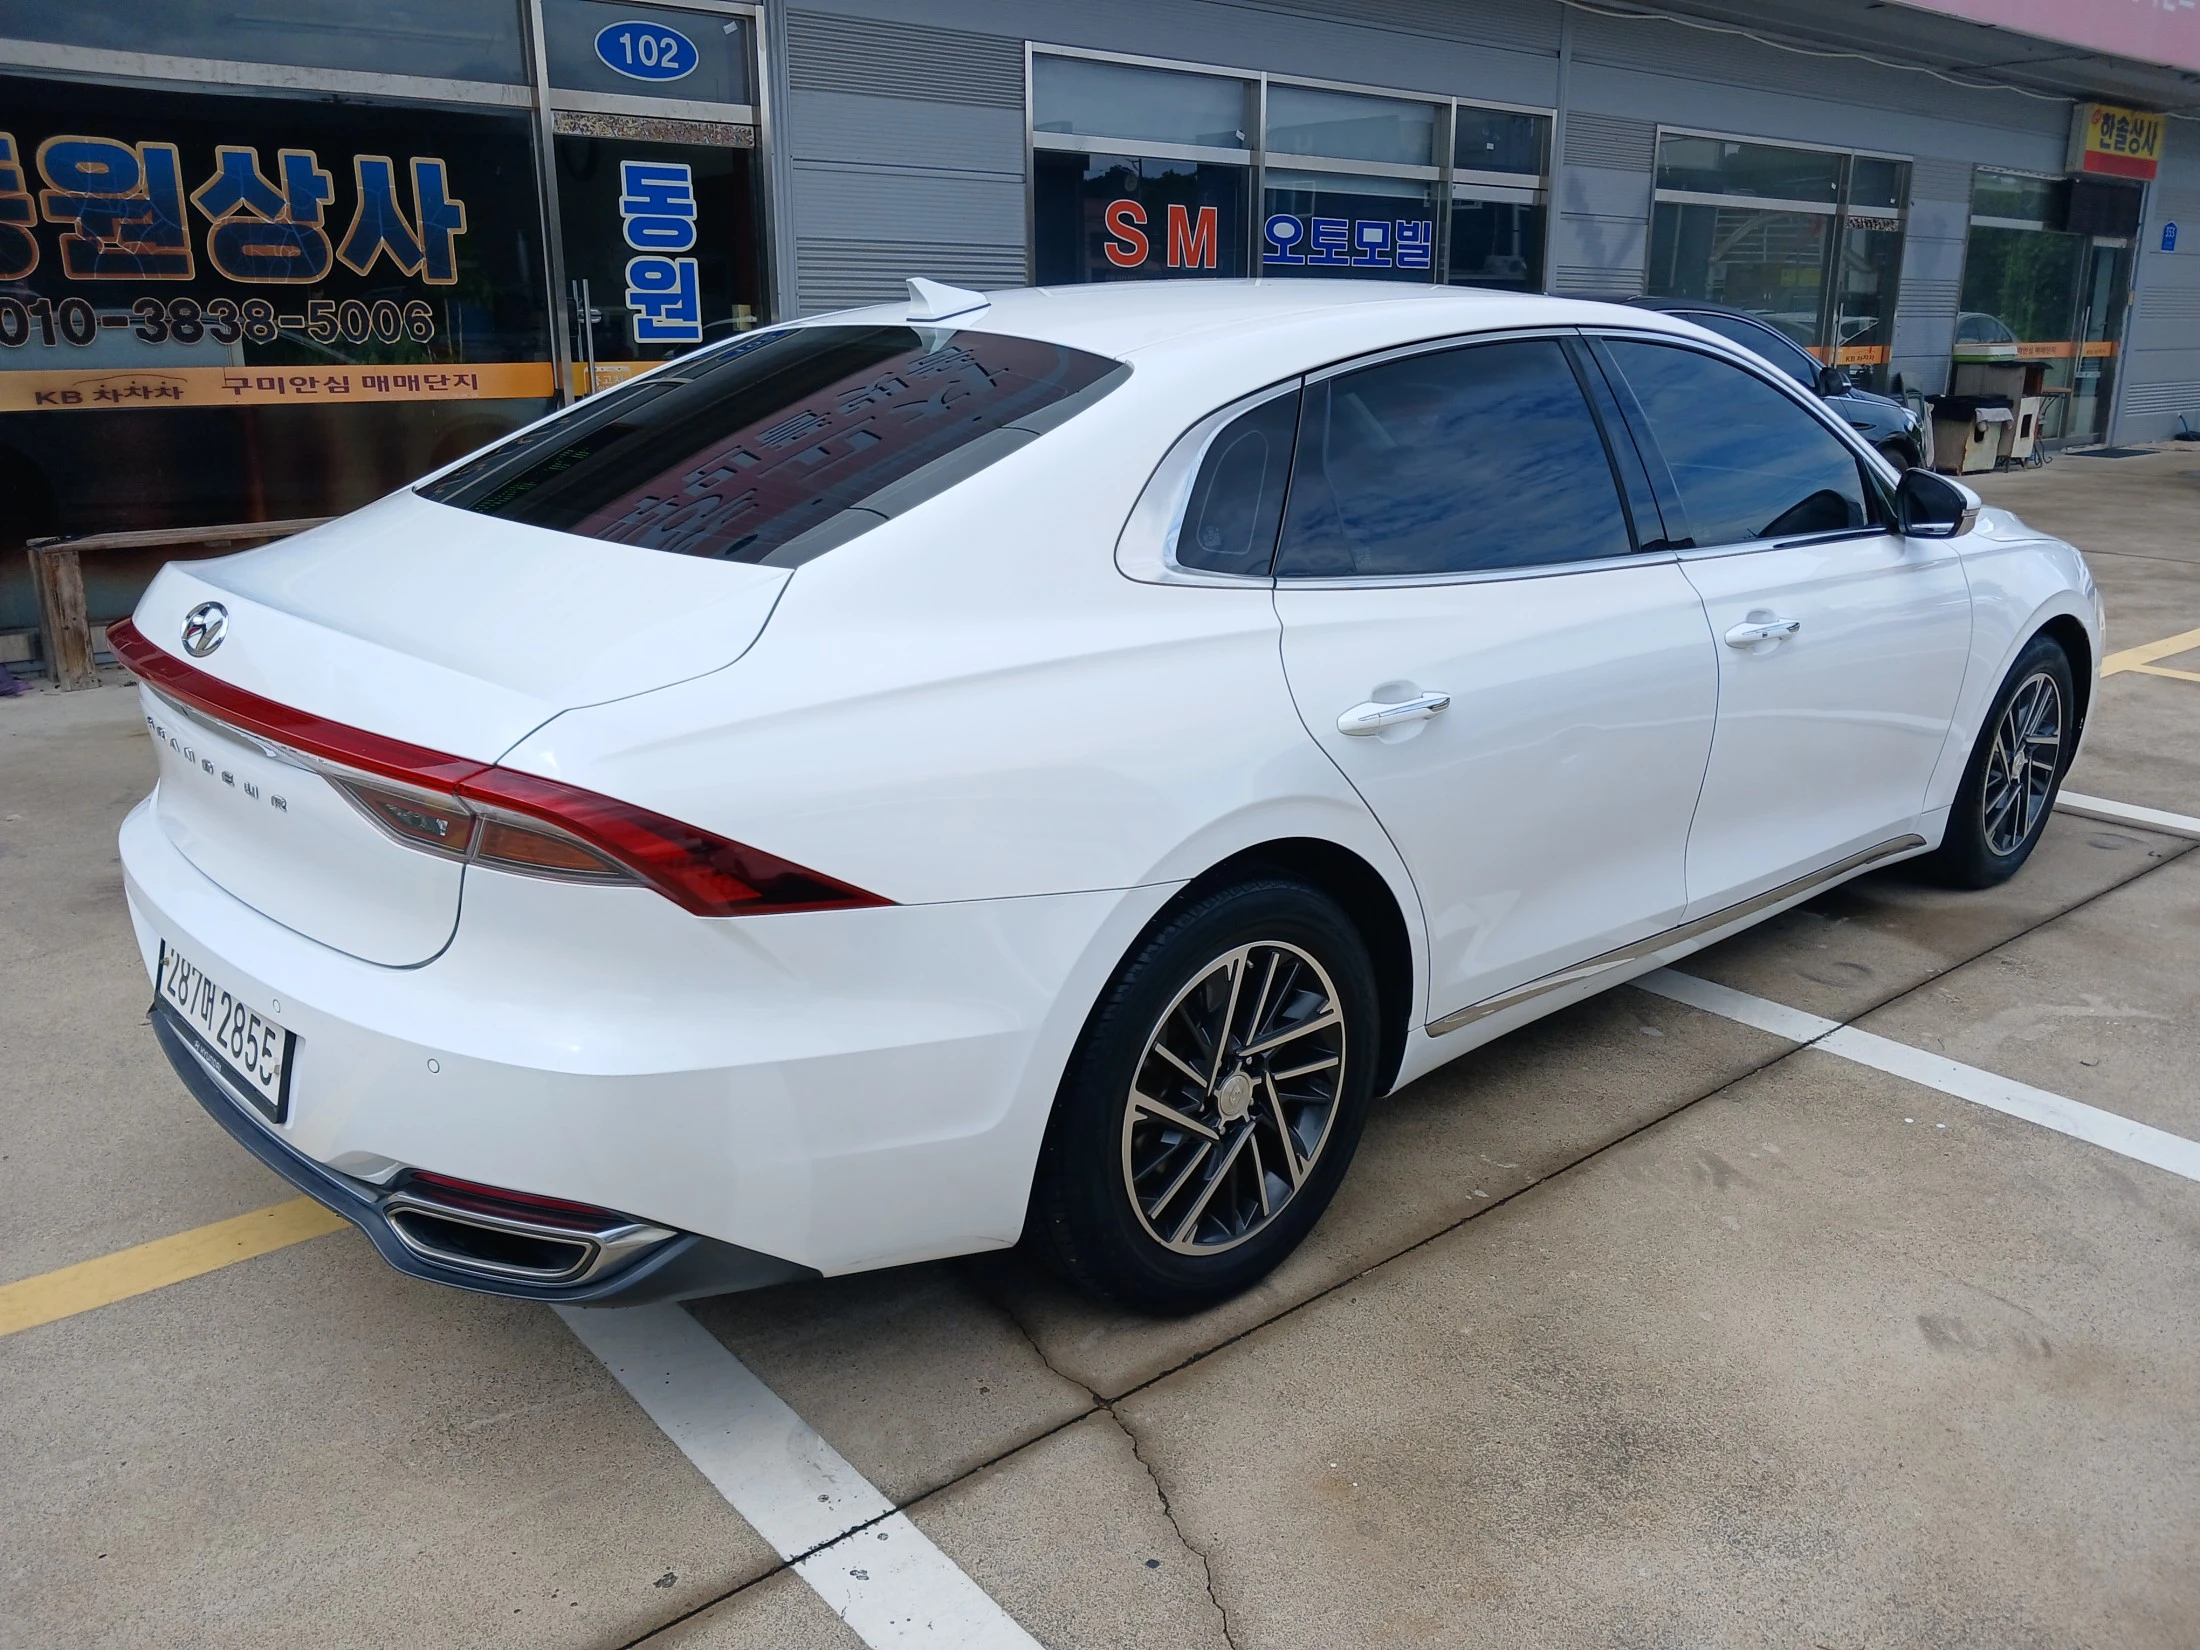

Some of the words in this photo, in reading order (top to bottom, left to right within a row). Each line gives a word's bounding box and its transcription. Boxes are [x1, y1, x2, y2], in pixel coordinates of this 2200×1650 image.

[619, 33, 679, 69] 102
[2100, 112, 2159, 157] 한솔상사
[0, 132, 467, 285] 원상사
[619, 160, 703, 343] 동원
[1263, 213, 1432, 269] 오토모빌
[0, 297, 436, 347] 010-3838-5006
[35, 391, 84, 405] KB
[93, 381, 184, 403] 차차차
[221, 376, 350, 395] 구미안심
[362, 373, 479, 392] 매매단지
[167, 948, 216, 1031] 287머
[216, 991, 276, 1086] 2855
